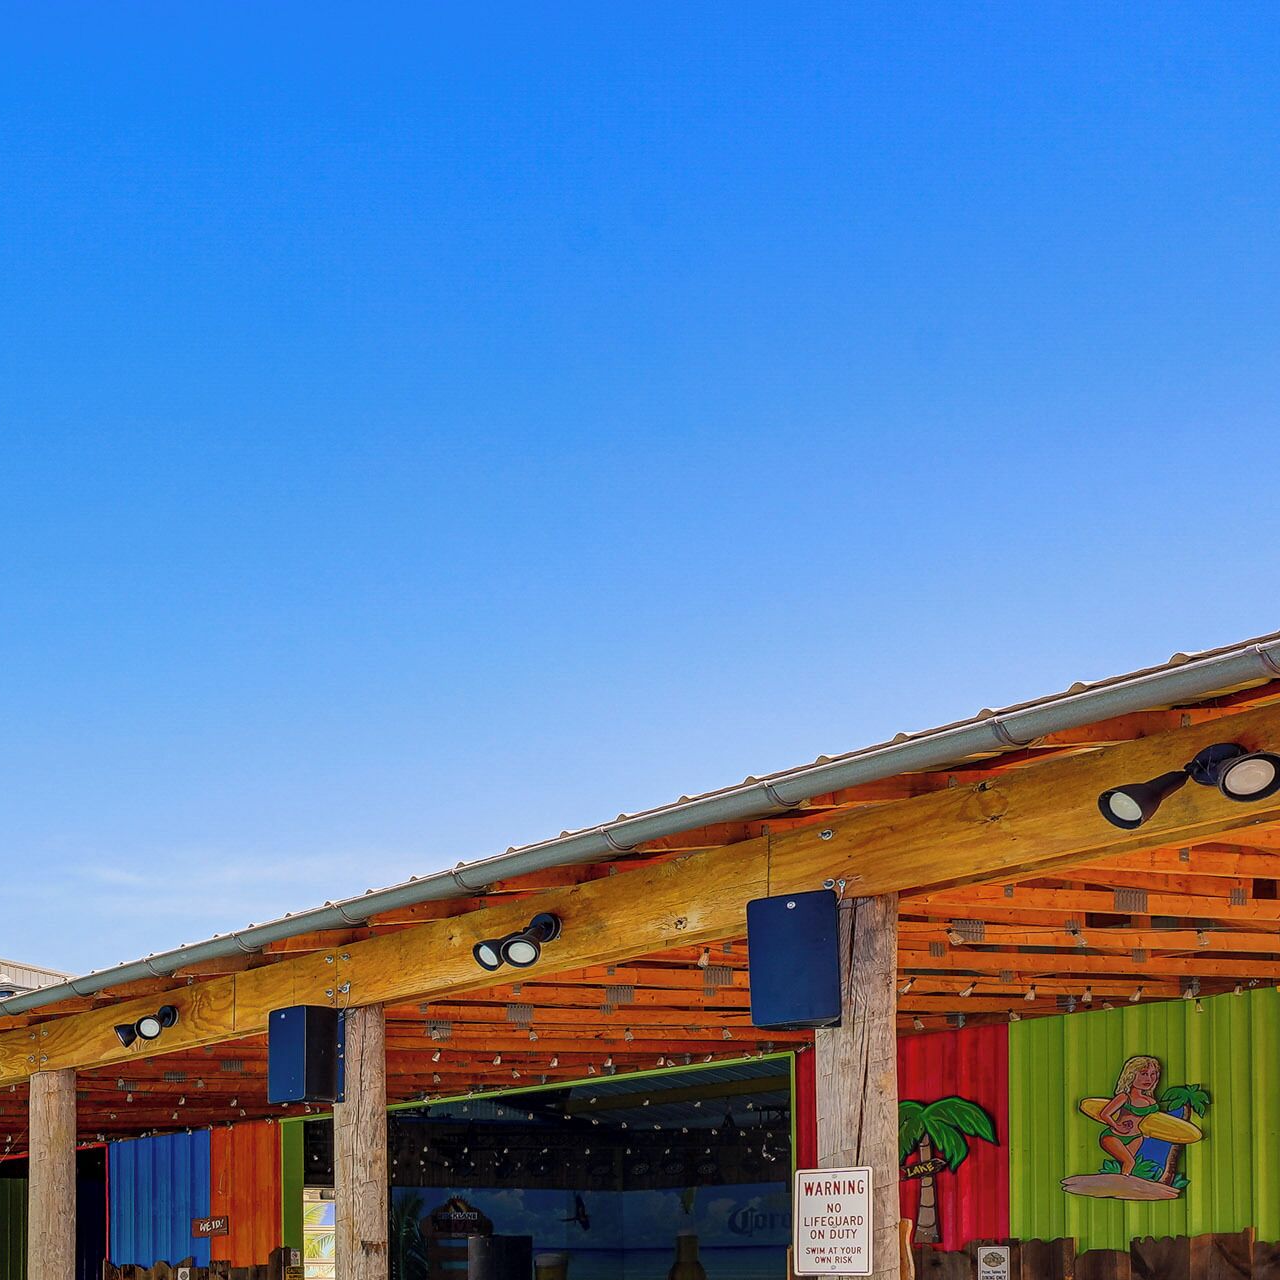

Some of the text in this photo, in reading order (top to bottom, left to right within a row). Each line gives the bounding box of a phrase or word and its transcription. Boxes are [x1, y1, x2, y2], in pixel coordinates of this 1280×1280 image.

[907, 1162, 935, 1177] LAKE
[804, 1180, 864, 1196] WARNING
[827, 1203, 842, 1213] NO
[199, 1221, 212, 1232] WE
[728, 1206, 791, 1237] Coro
[804, 1216, 864, 1227] LIFEGUARD
[810, 1229, 857, 1239] ON DUTY
[806, 1246, 862, 1255] SWIM AT YOUR
[814, 1256, 853, 1264] OWN RISK
